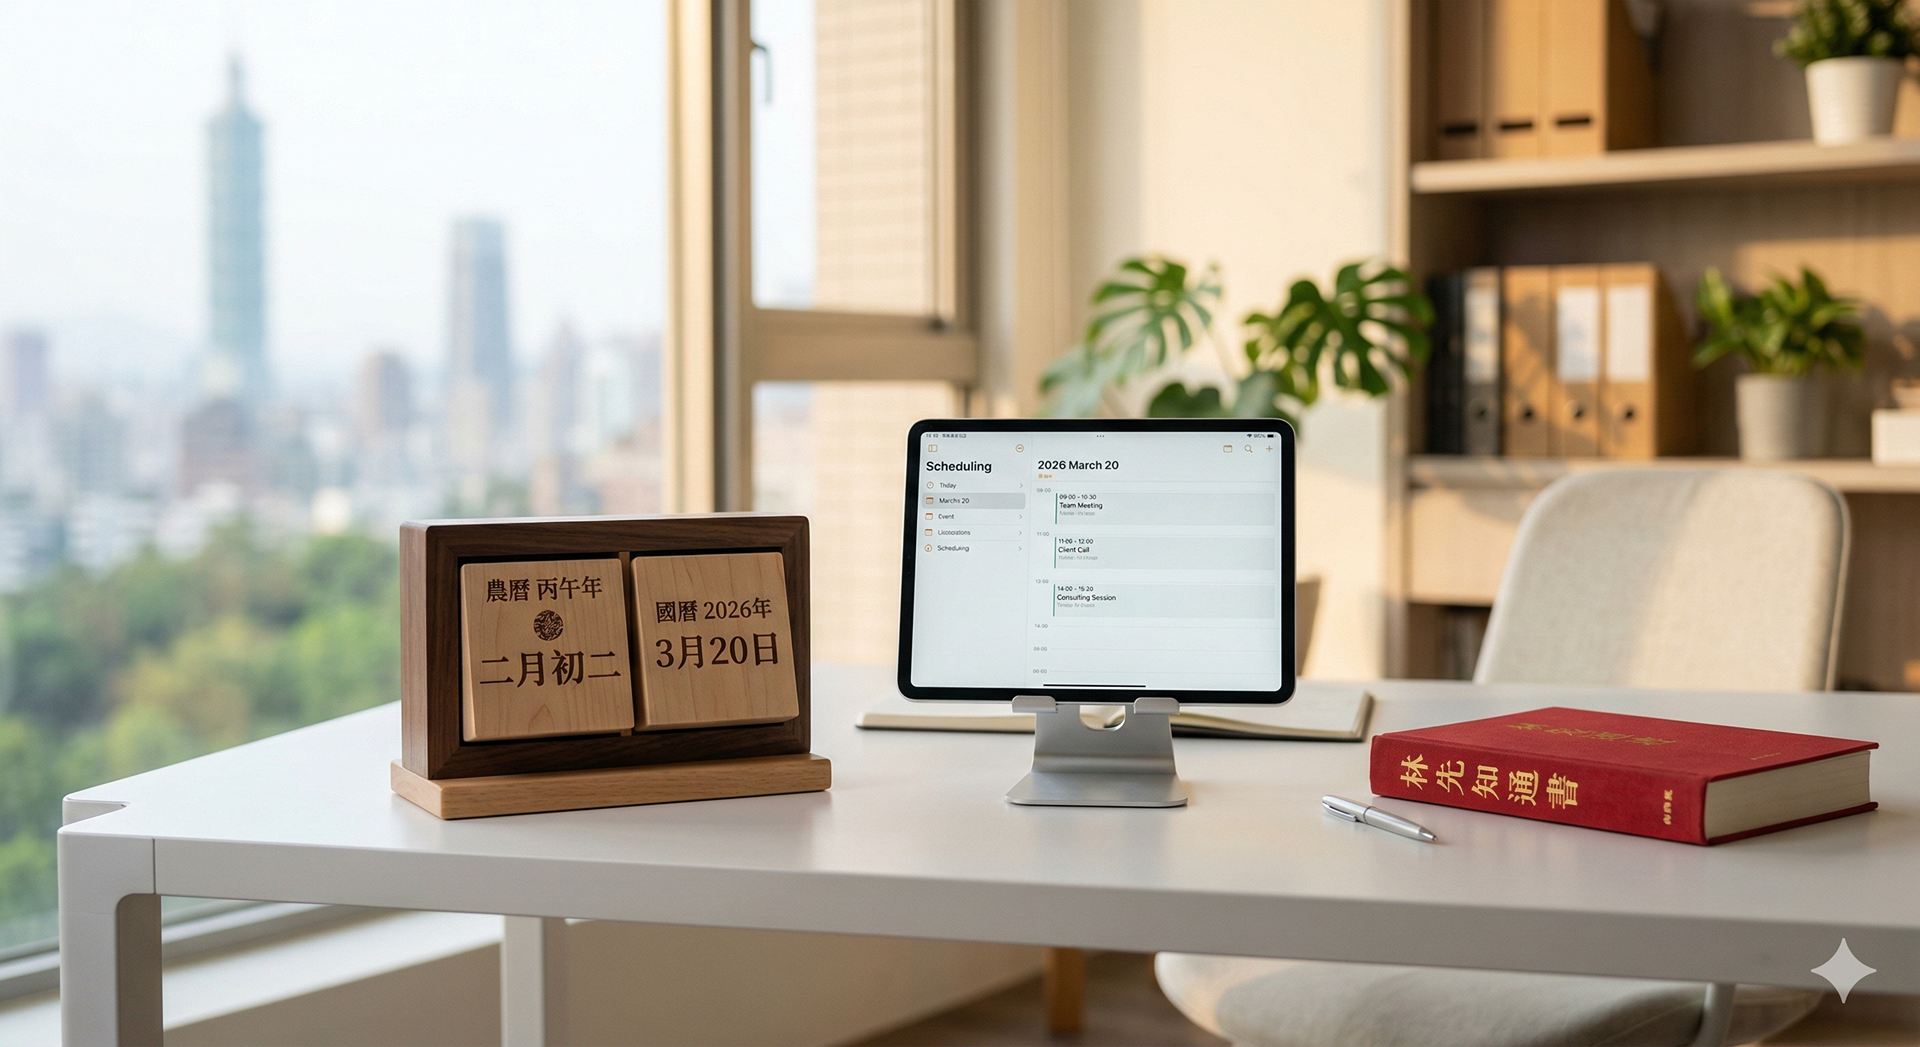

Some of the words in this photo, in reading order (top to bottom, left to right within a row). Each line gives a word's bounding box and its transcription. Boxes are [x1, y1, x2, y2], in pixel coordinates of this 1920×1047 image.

[926, 461, 992, 474] Scheduling
[1037, 460, 1067, 470] 2026
[1068, 460, 1102, 470] March
[1104, 460, 1119, 470] 20
[1077, 502, 1103, 510] Meeting
[486, 578, 530, 604] 農曆
[537, 576, 603, 601] 丙午年
[655, 600, 698, 624] 國曆
[703, 597, 772, 621] 2026年
[655, 632, 779, 670] 3月20日
[480, 649, 621, 688] 二月初二
[1400, 753, 1579, 810] 林先知通書
